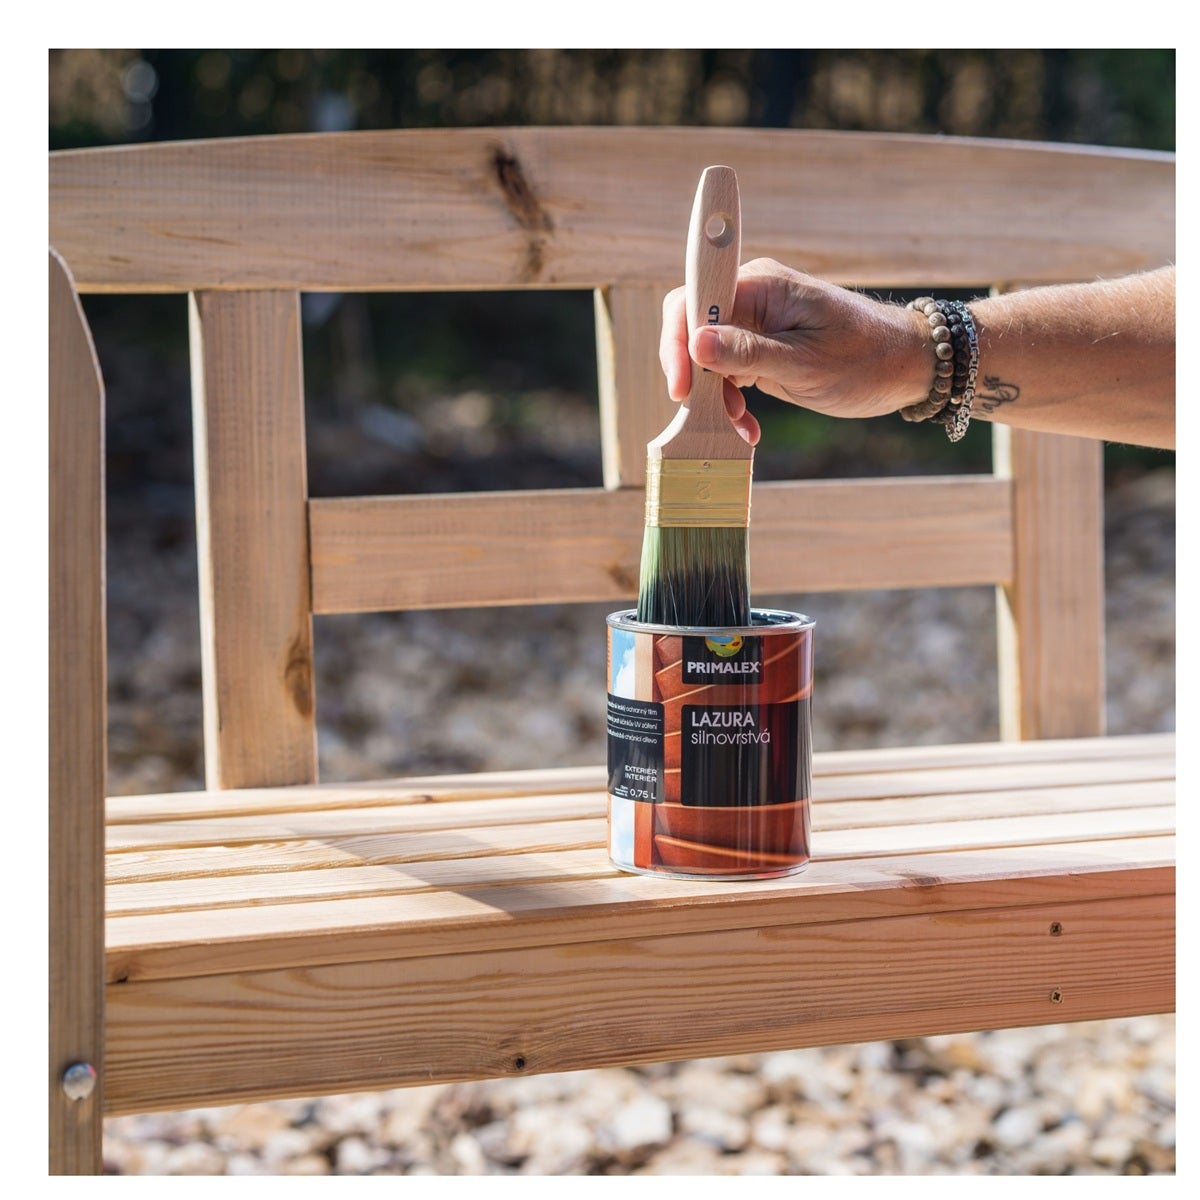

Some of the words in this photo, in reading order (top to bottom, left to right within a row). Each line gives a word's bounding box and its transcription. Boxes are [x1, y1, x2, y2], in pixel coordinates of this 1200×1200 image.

[708, 305, 720, 326] LD
[687, 661, 760, 674] PRIMALEX
[691, 711, 755, 727] LAZURA
[691, 728, 770, 745] silnovrstvá
[630, 788, 649, 799] 0,75
[650, 792, 657, 800] L
